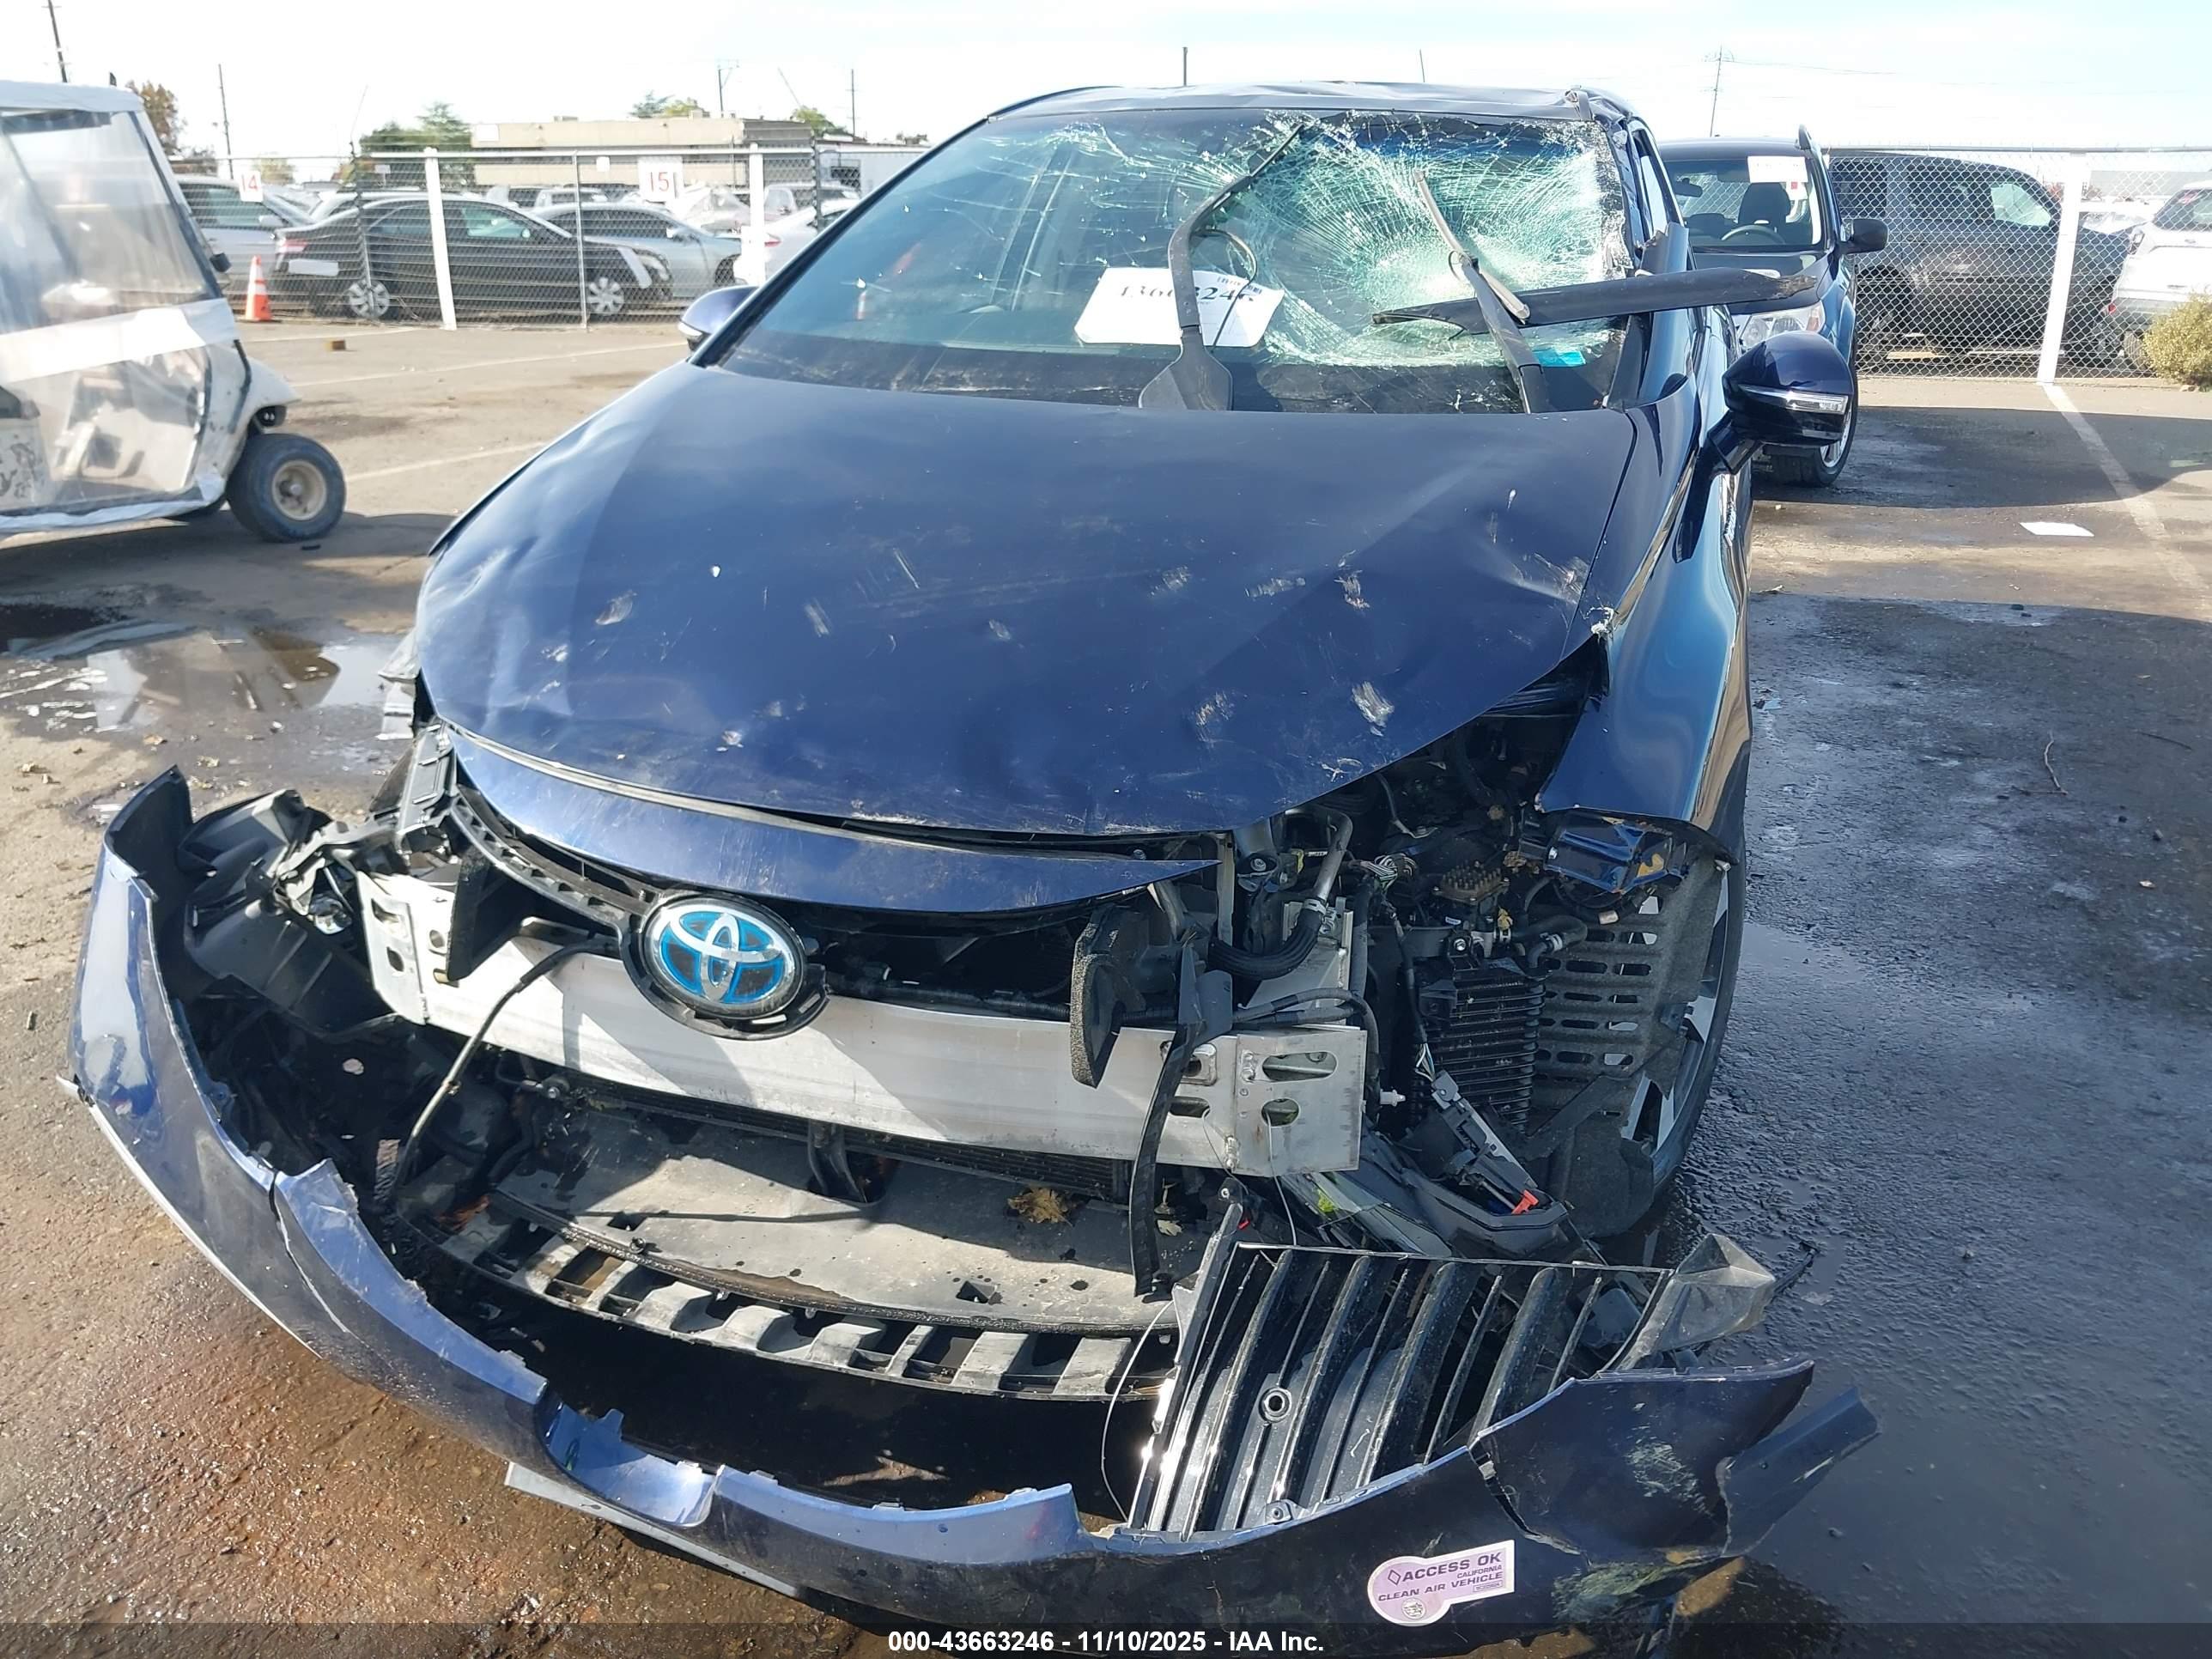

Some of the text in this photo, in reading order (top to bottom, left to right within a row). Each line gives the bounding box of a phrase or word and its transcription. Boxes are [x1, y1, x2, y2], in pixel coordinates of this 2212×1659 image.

[1402, 1552, 1502, 1582] ACCESS OK
[1456, 1565, 1503, 1579] CALIFORNIA
[1377, 1588, 1419, 1602] CLEAN
[1424, 1583, 1446, 1594] AIR
[1450, 1571, 1504, 1588] VEHICLE
